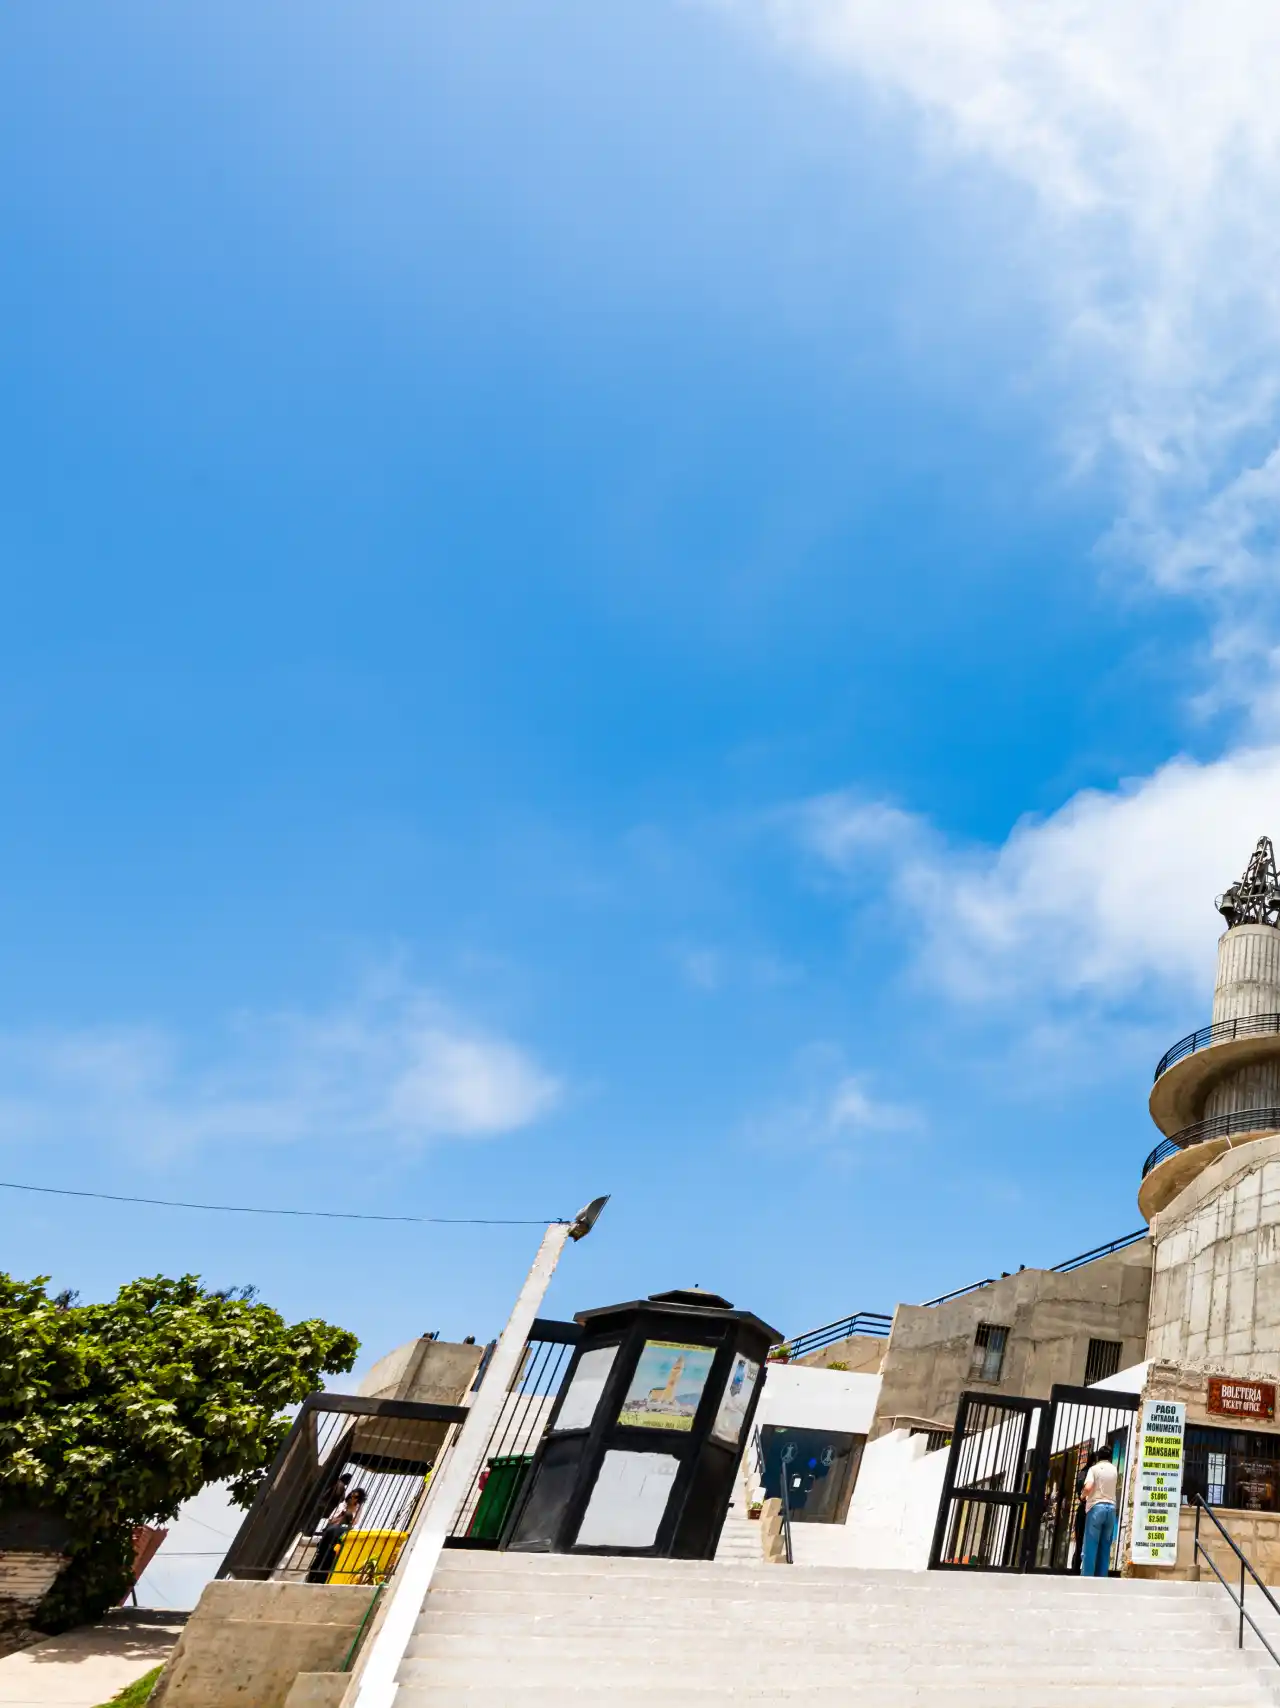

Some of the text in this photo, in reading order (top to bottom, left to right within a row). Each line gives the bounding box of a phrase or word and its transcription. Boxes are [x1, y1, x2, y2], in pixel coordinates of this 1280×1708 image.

[1156, 1405, 1176, 1414] PAGO
[1222, 1399, 1260, 1412] TICKET OFFICE
[1151, 1414, 1174, 1423] ENTRADA
[1146, 1423, 1182, 1434] MONUMENTO
[1145, 1446, 1180, 1458] TRANSBANK
